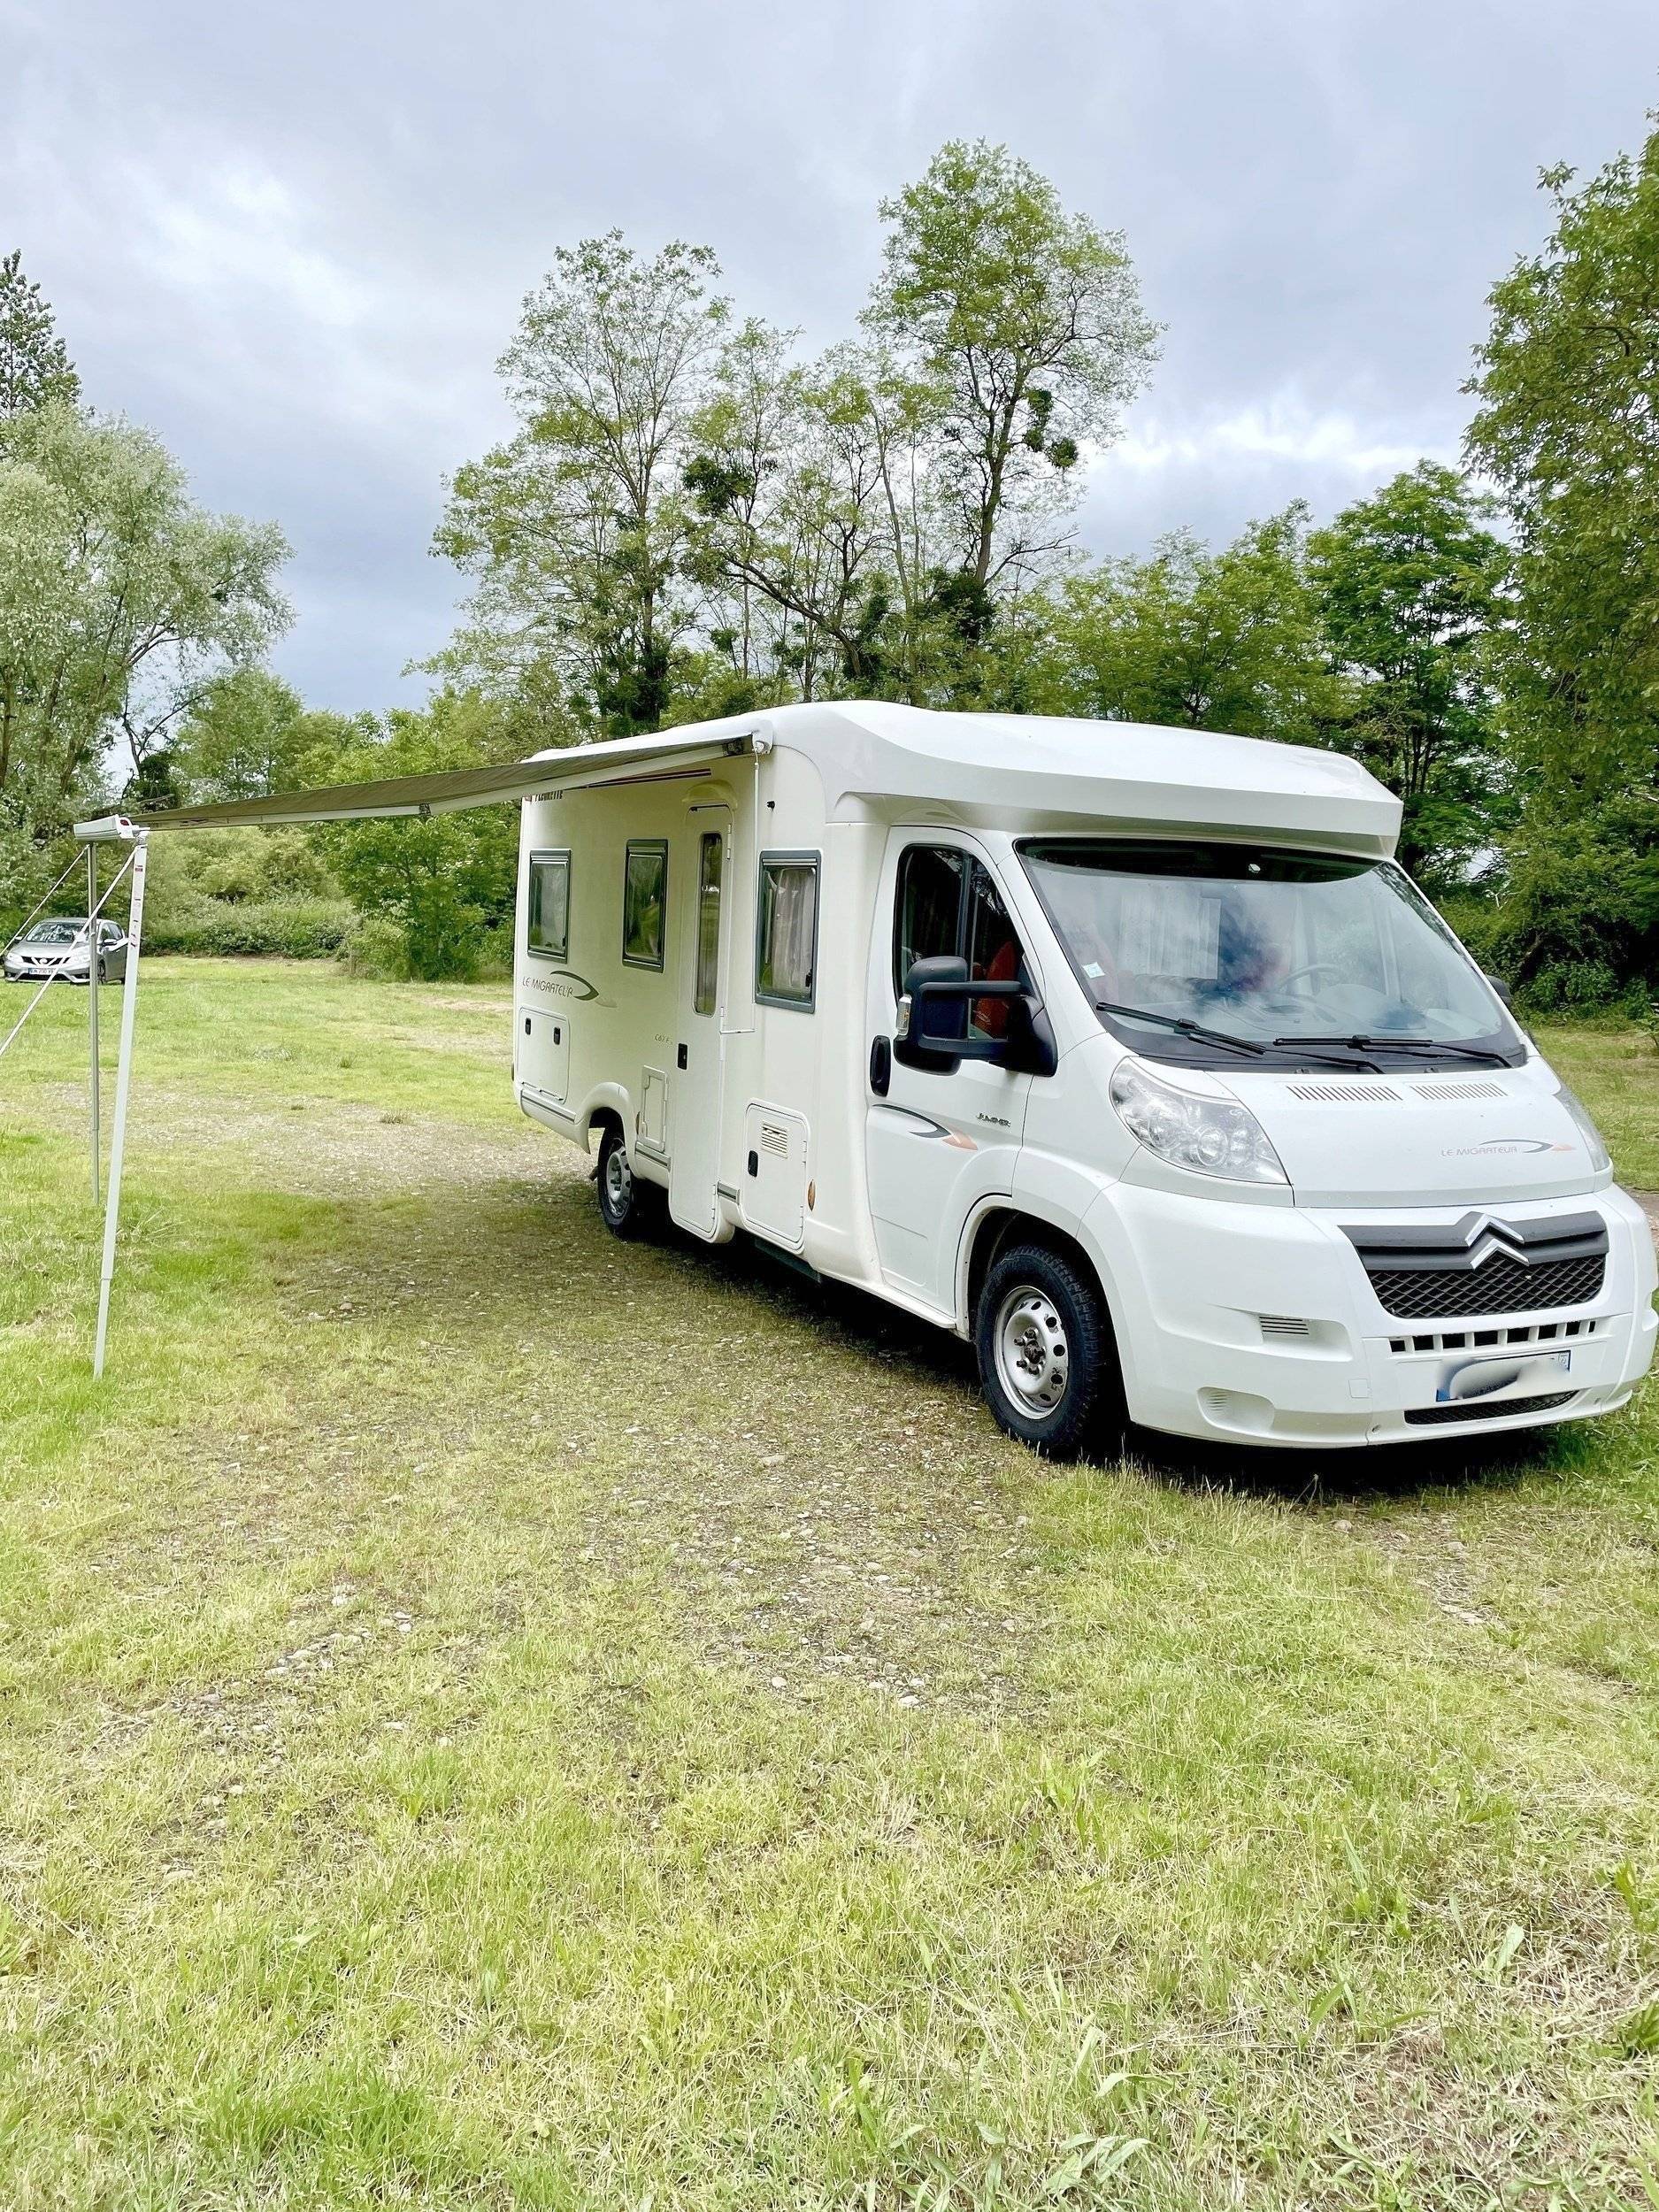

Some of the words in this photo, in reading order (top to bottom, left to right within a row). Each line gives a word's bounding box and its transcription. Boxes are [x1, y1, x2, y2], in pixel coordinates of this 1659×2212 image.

[522, 976, 532, 987] LE
[532, 979, 573, 998] MIGRATEUR
[1456, 1146, 1518, 1156] MIGRATEUR
